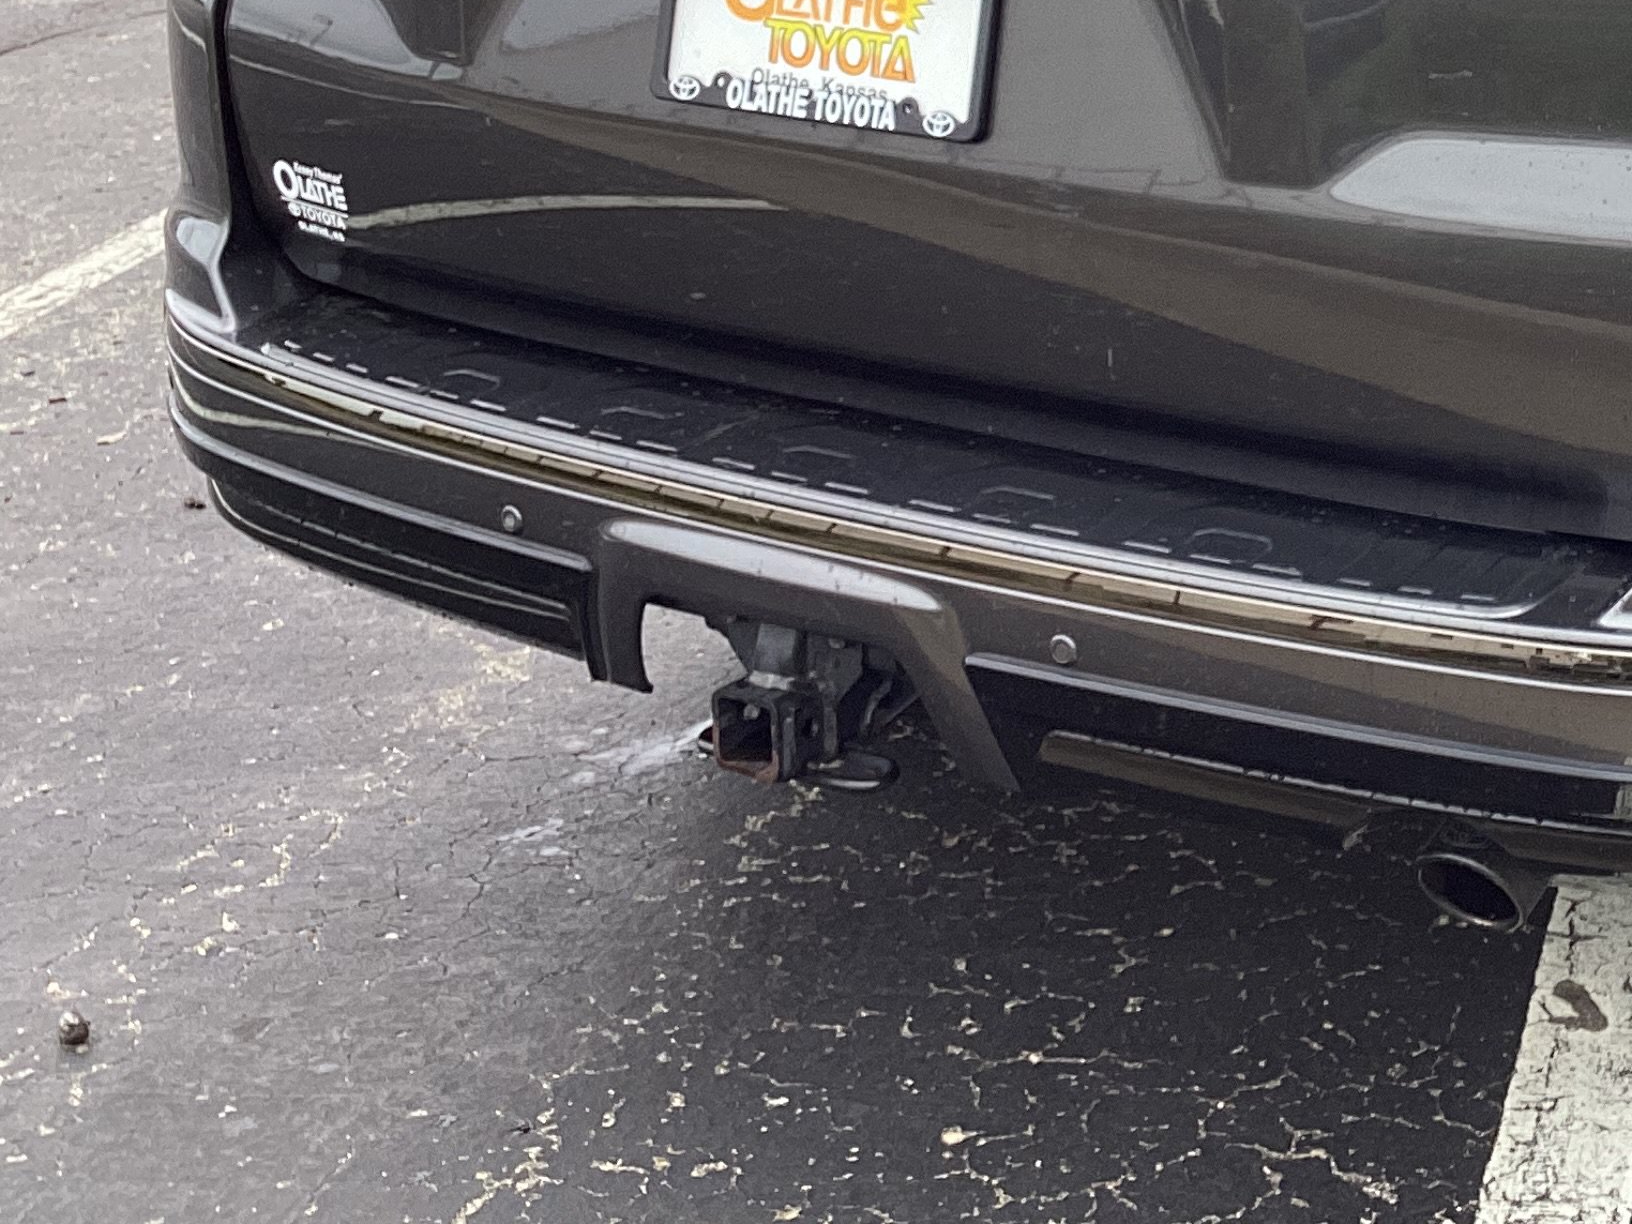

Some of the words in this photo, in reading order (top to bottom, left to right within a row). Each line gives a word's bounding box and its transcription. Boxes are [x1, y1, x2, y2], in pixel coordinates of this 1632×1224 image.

[764, 19, 916, 82] TOYOTA
[726, 79, 808, 118] OLATHE
[814, 90, 896, 131] TOYOTA
[273, 160, 348, 210] OLATHE
[300, 207, 346, 230] TOYOTA
